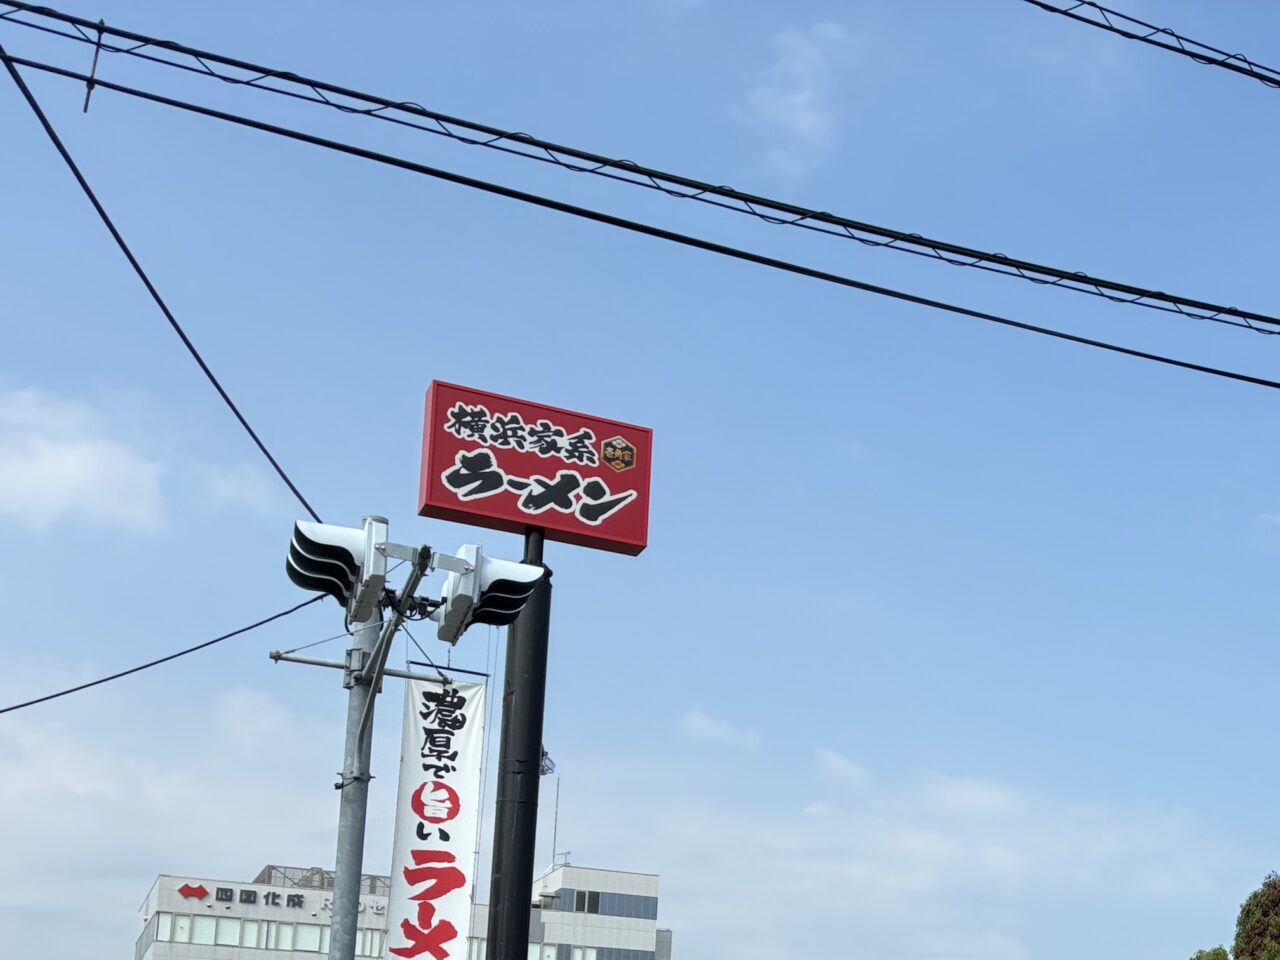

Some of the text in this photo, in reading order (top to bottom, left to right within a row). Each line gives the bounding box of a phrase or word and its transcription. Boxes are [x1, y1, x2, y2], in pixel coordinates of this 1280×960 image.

[446, 403, 598, 466] 横浜家系
[443, 450, 636, 524] ラーメン
[215, 887, 305, 909] 四国化成
